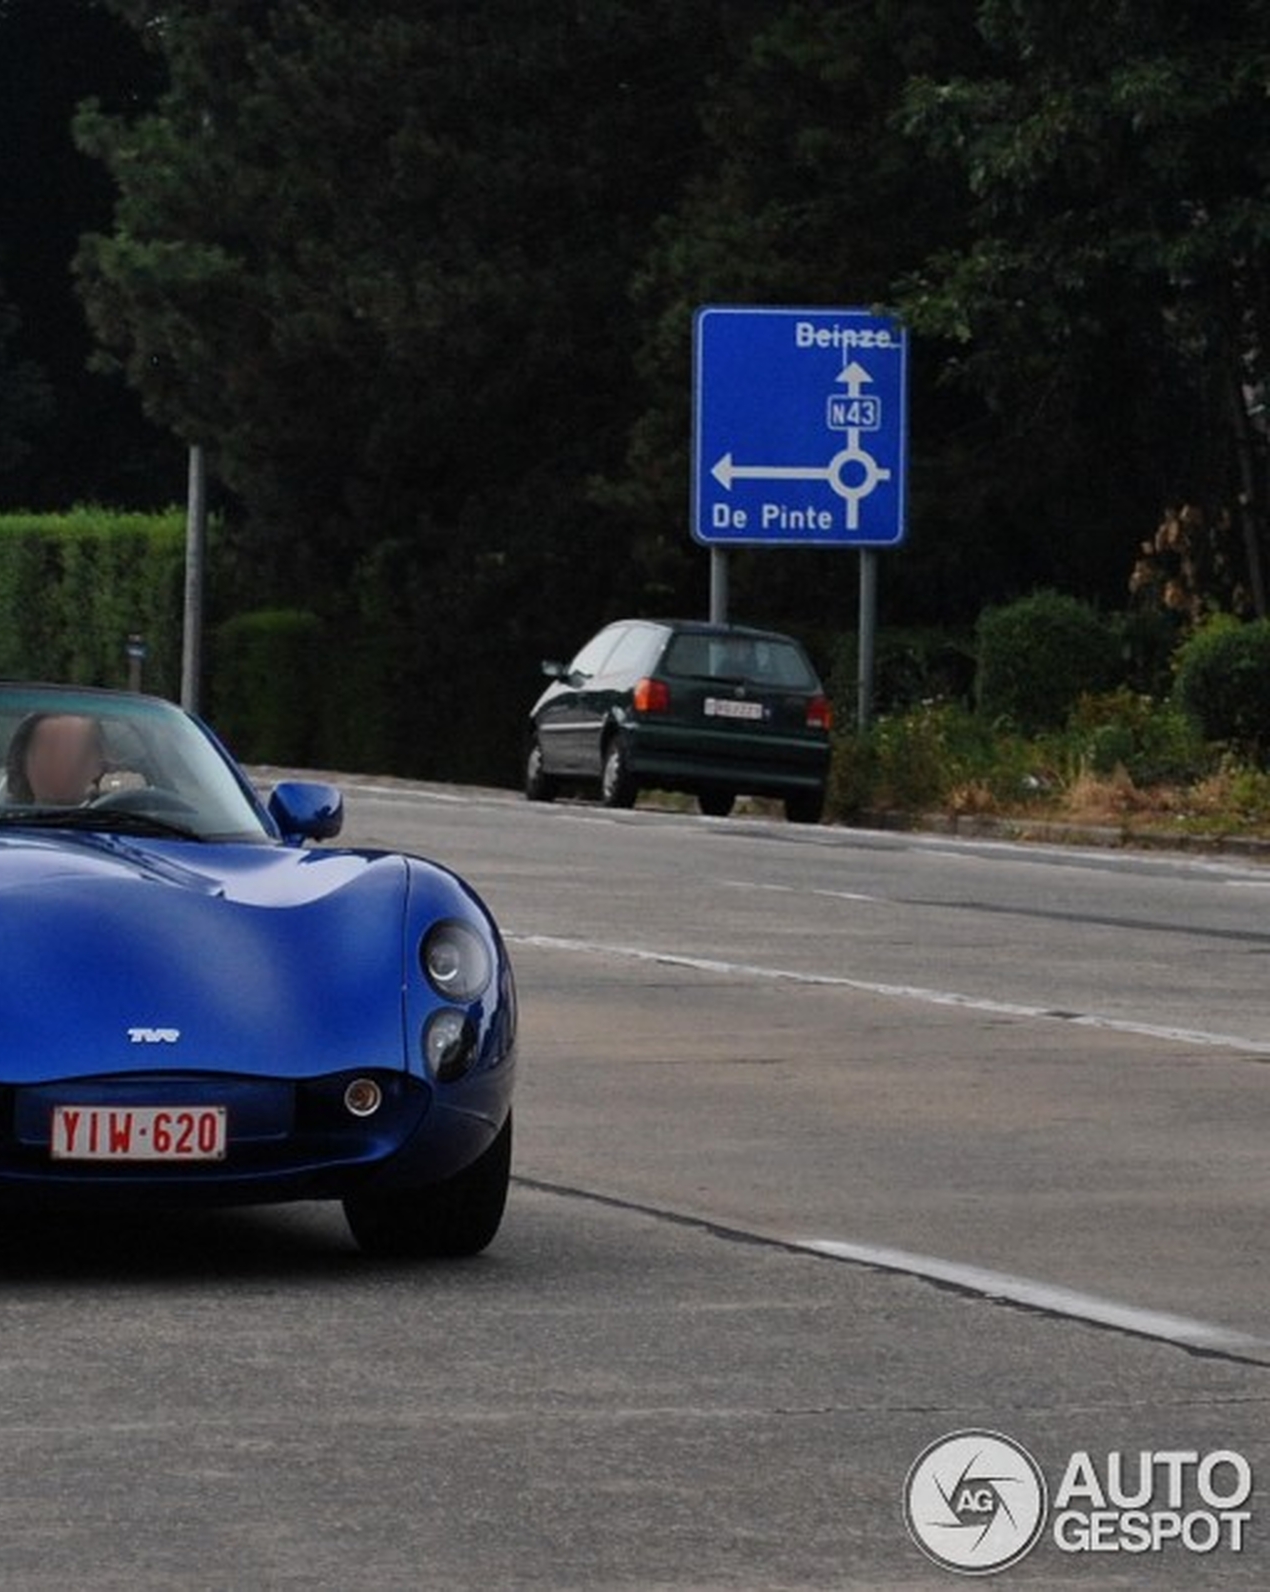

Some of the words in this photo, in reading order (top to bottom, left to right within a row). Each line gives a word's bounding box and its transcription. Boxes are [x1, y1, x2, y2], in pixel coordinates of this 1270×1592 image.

[833, 402, 874, 425] N43
[713, 504, 747, 528] De
[762, 504, 832, 529] Pinte
[128, 1028, 180, 1043] TVR
